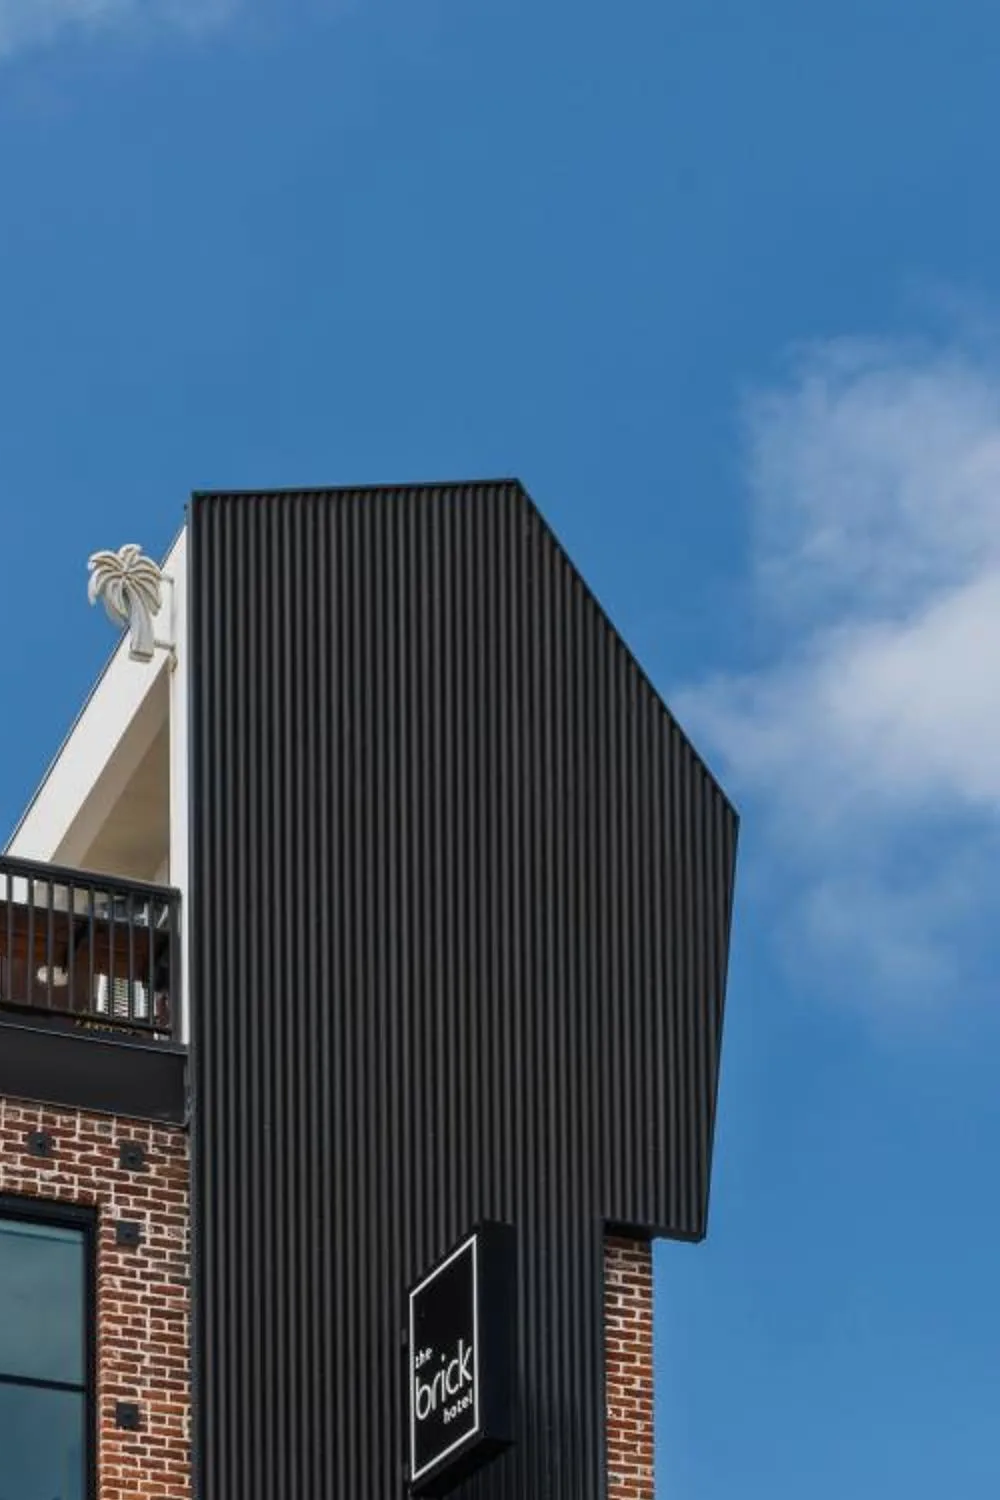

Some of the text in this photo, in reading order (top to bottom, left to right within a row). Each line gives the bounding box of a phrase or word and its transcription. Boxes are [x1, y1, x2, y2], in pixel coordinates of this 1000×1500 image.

[415, 1347, 433, 1369] the
[415, 1338, 473, 1421] brick
[443, 1388, 473, 1425] hotel
